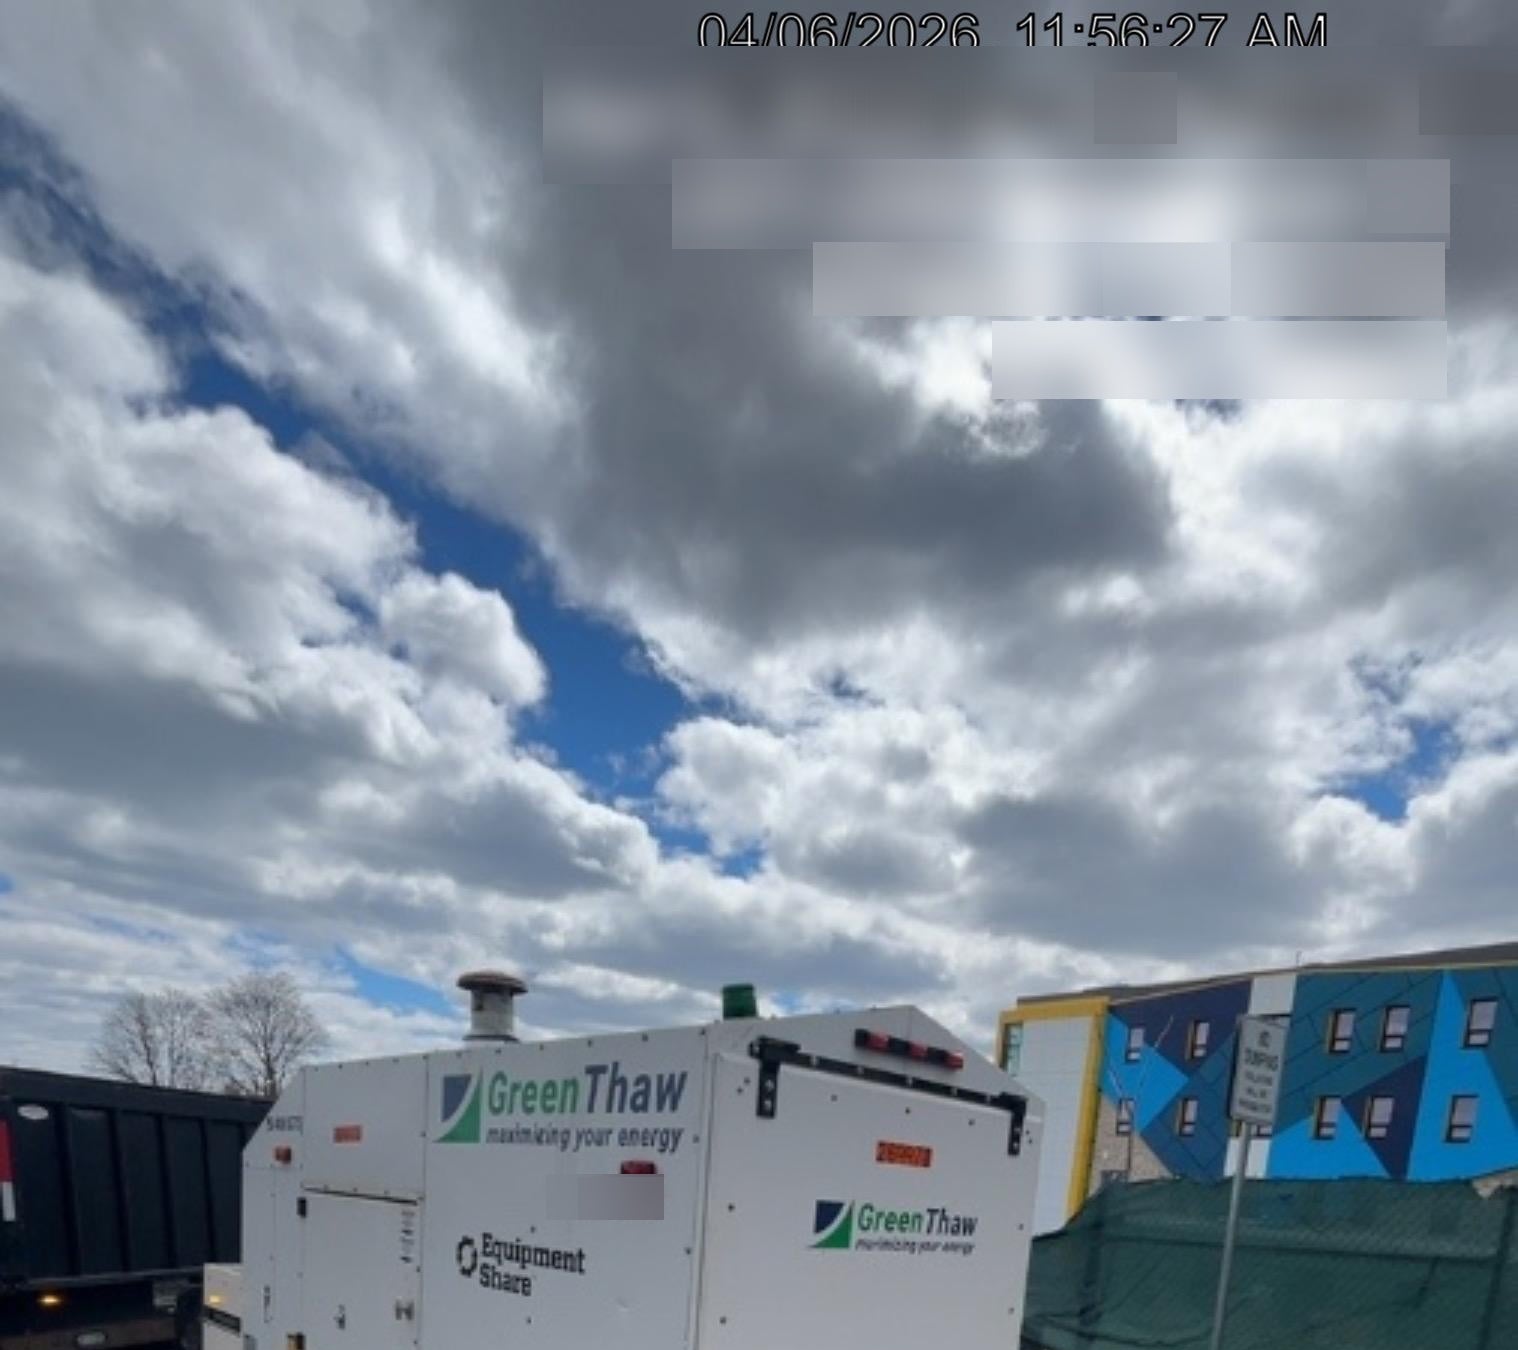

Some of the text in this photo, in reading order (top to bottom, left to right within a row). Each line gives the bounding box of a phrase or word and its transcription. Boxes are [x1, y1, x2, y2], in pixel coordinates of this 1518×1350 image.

[486, 1123, 685, 1153] maximizing your energy
[482, 1232, 585, 1275] Equipment
[480, 1262, 532, 1296] Share
